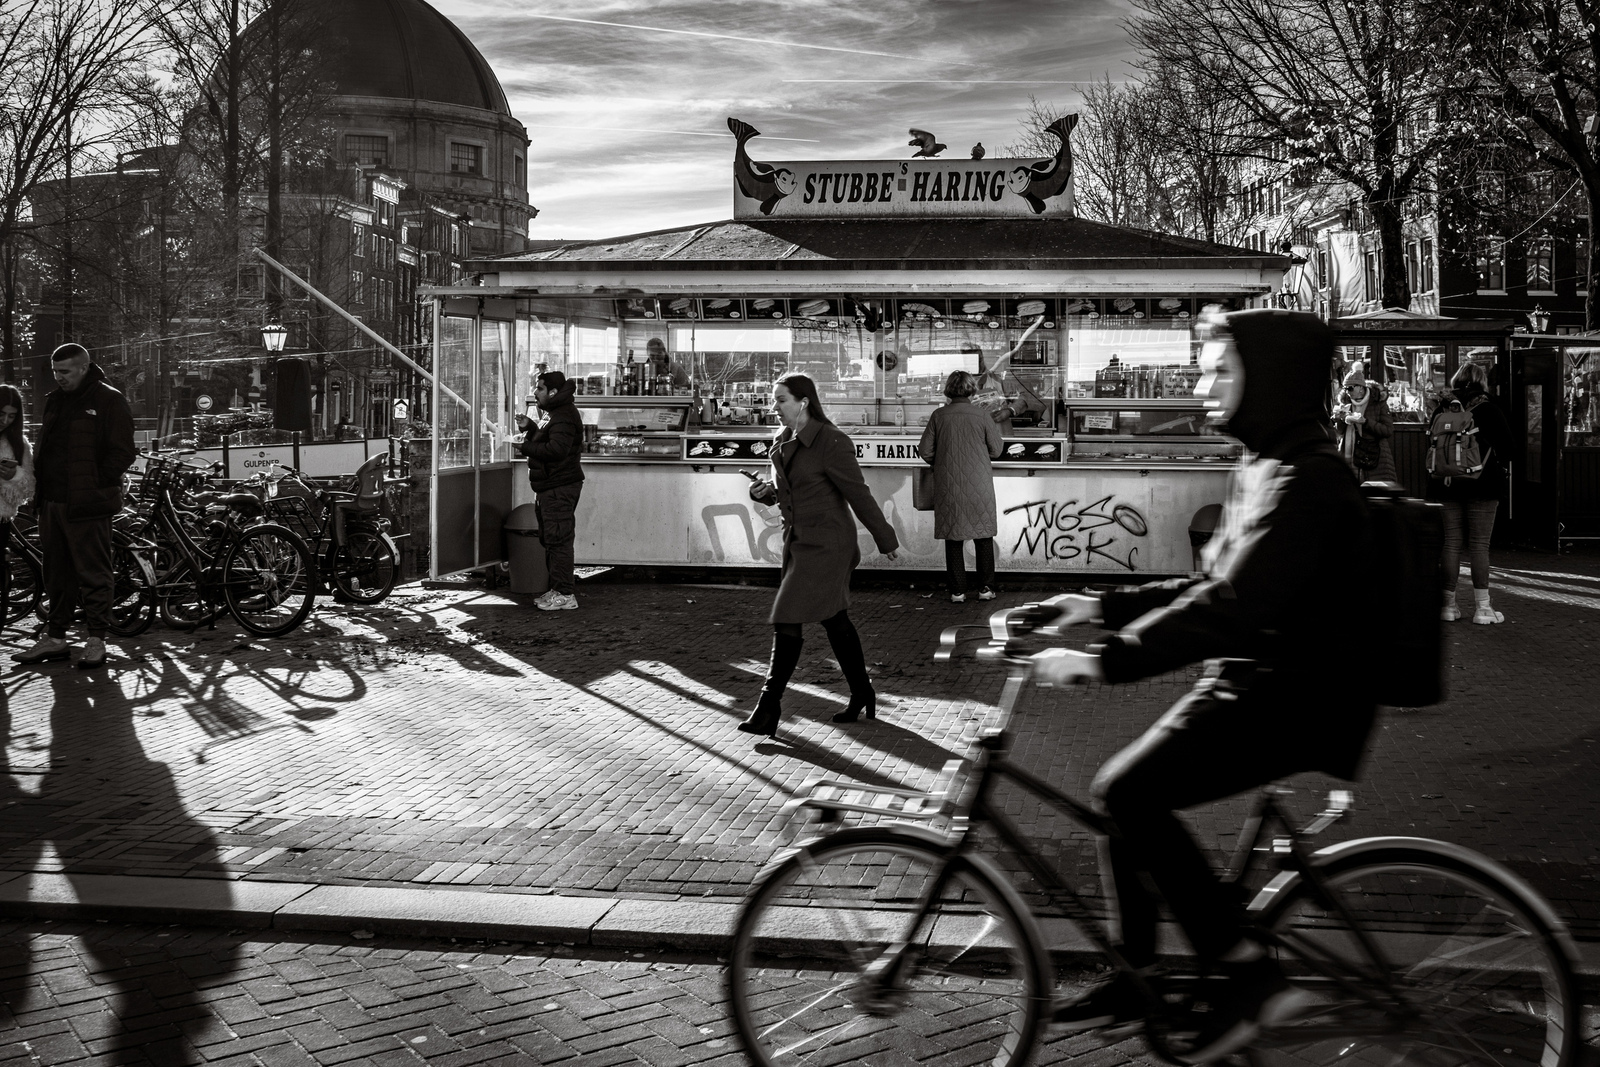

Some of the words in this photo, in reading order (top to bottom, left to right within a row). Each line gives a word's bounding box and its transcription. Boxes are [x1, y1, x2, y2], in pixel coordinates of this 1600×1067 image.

[910, 170, 1006, 203] HARING
[876, 444, 921, 460] HARIN
[243, 459, 280, 468] GULPENER
